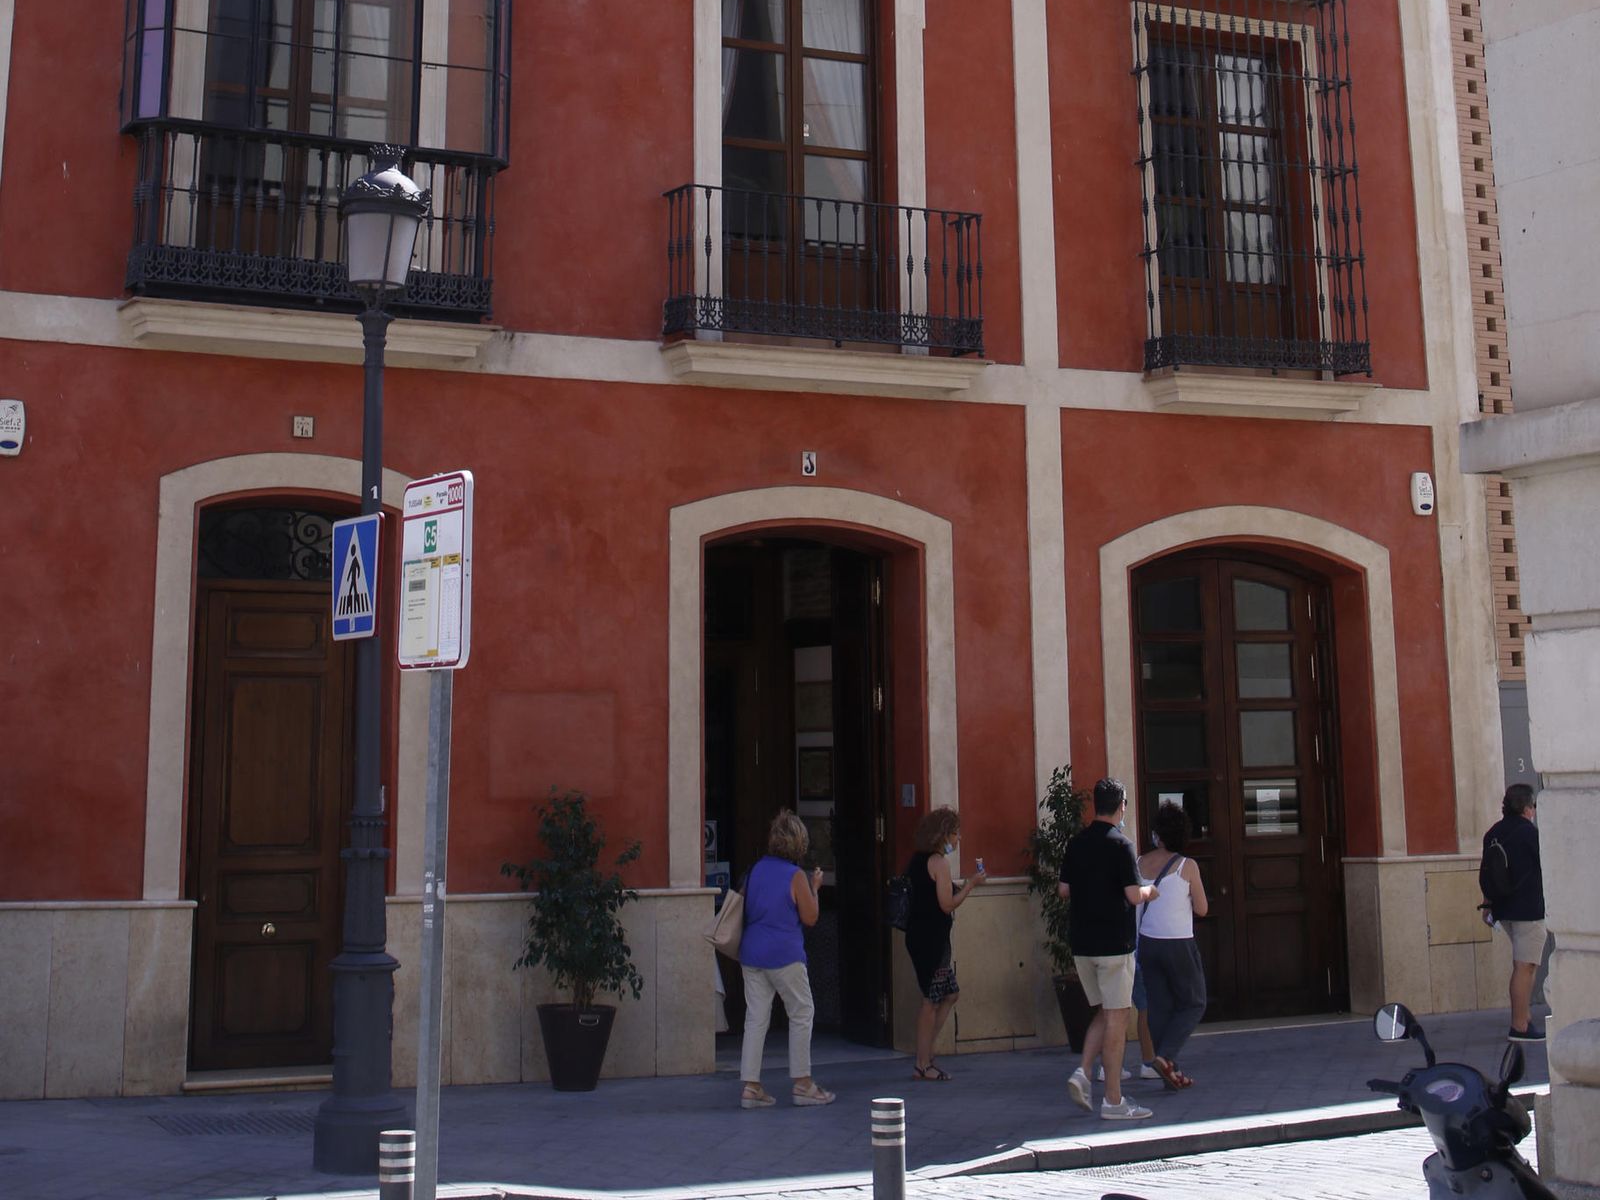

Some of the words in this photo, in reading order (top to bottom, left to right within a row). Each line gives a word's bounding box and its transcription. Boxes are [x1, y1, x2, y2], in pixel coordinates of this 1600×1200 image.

[370, 485, 378, 499] 1
[424, 526, 437, 547] C5
[1517, 757, 1525, 773] 3
